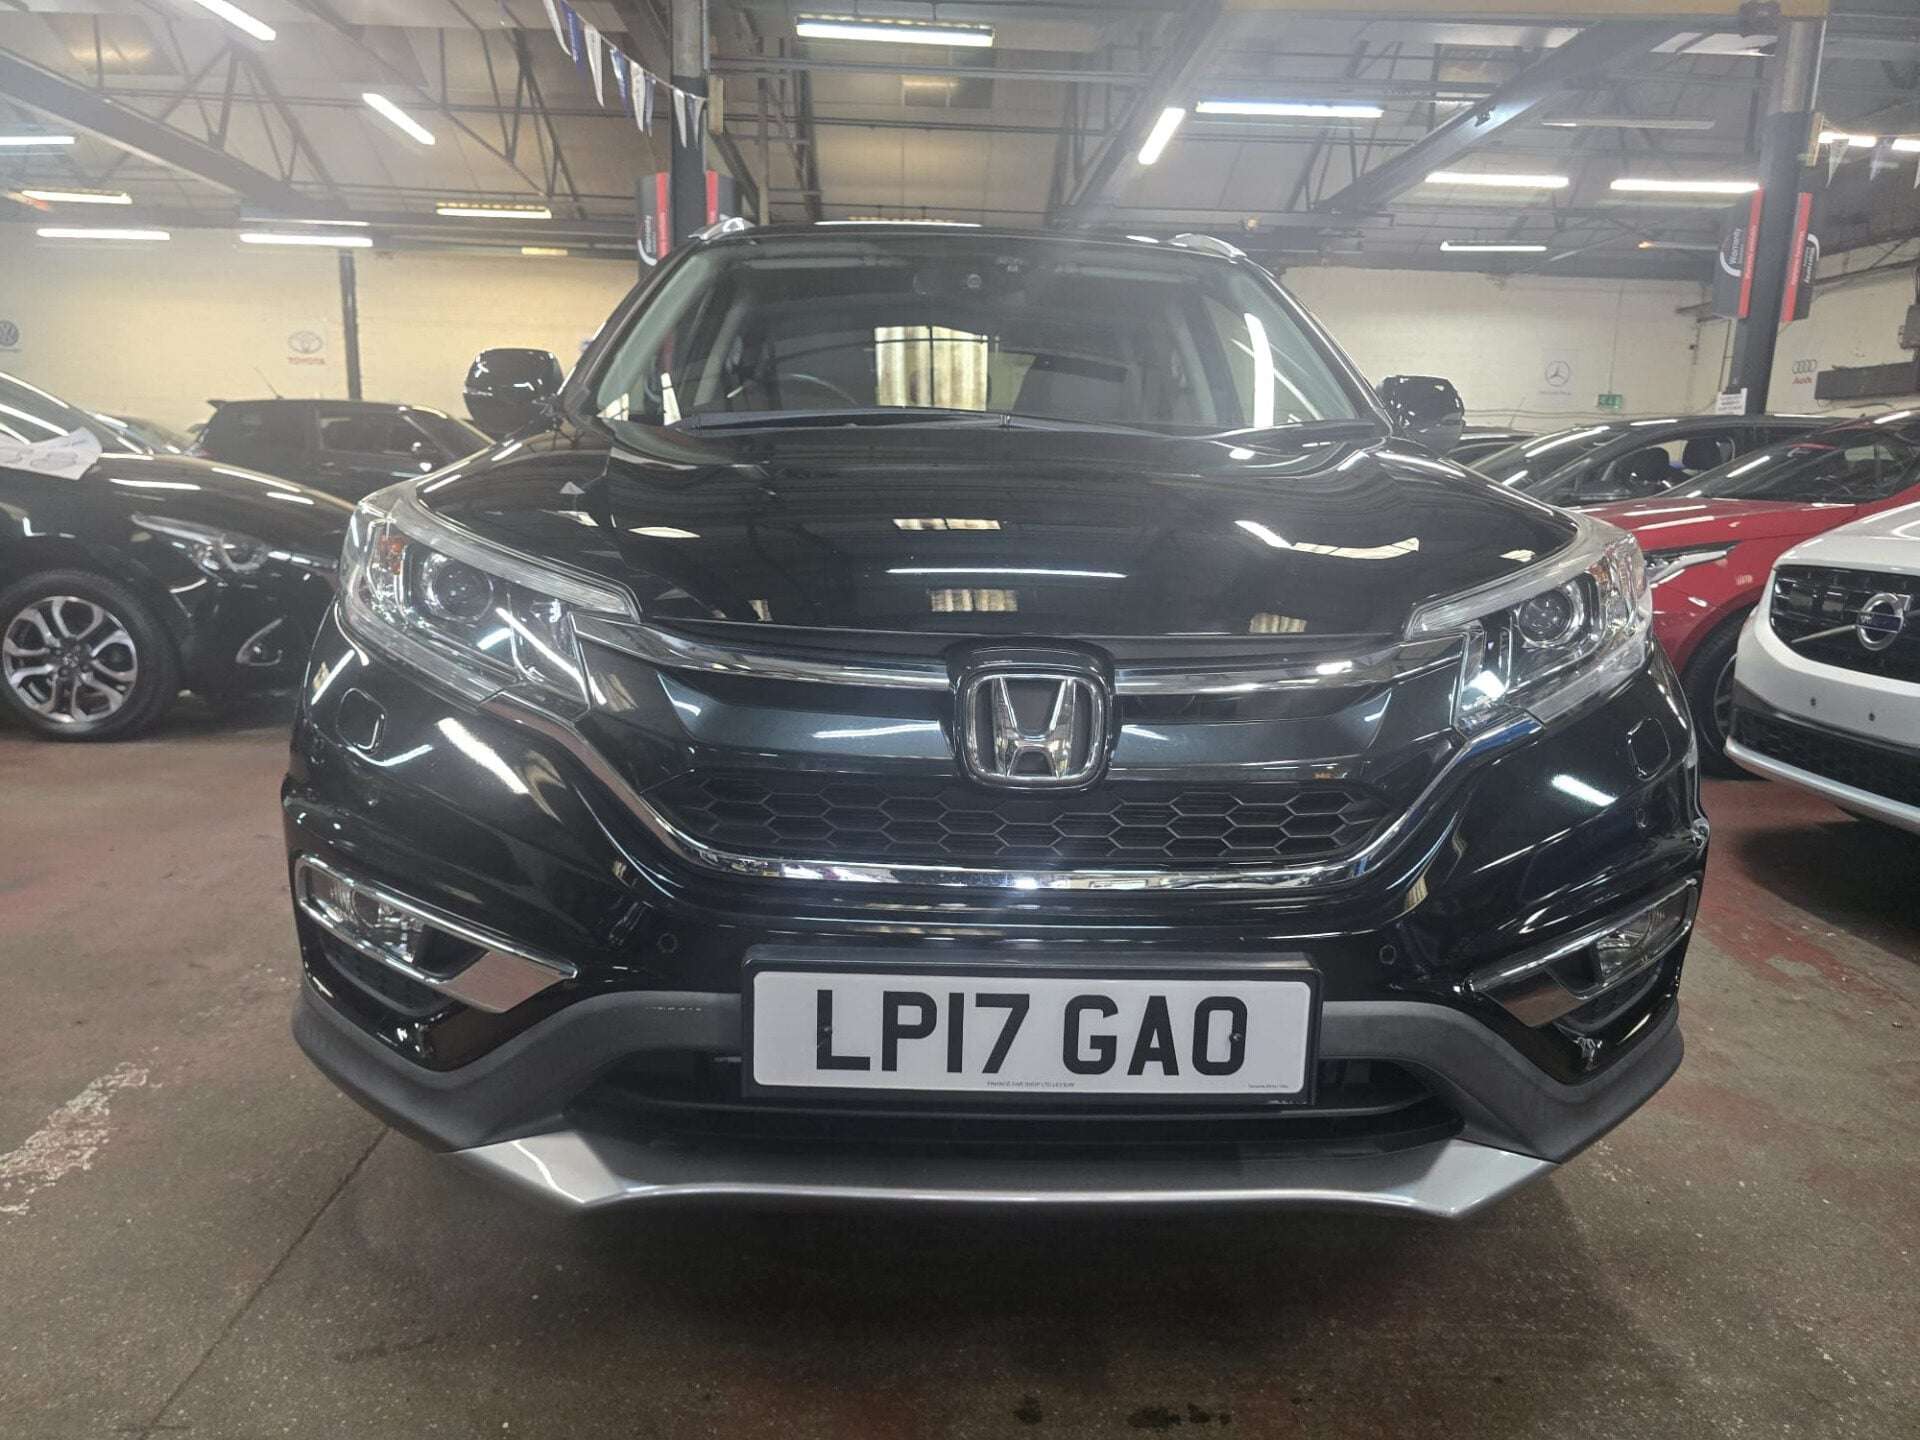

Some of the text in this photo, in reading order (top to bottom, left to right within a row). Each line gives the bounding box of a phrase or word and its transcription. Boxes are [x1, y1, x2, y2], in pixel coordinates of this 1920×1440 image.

[1728, 228, 1743, 264] Warranty
[817, 989, 1248, 1076] LP17 GAO
